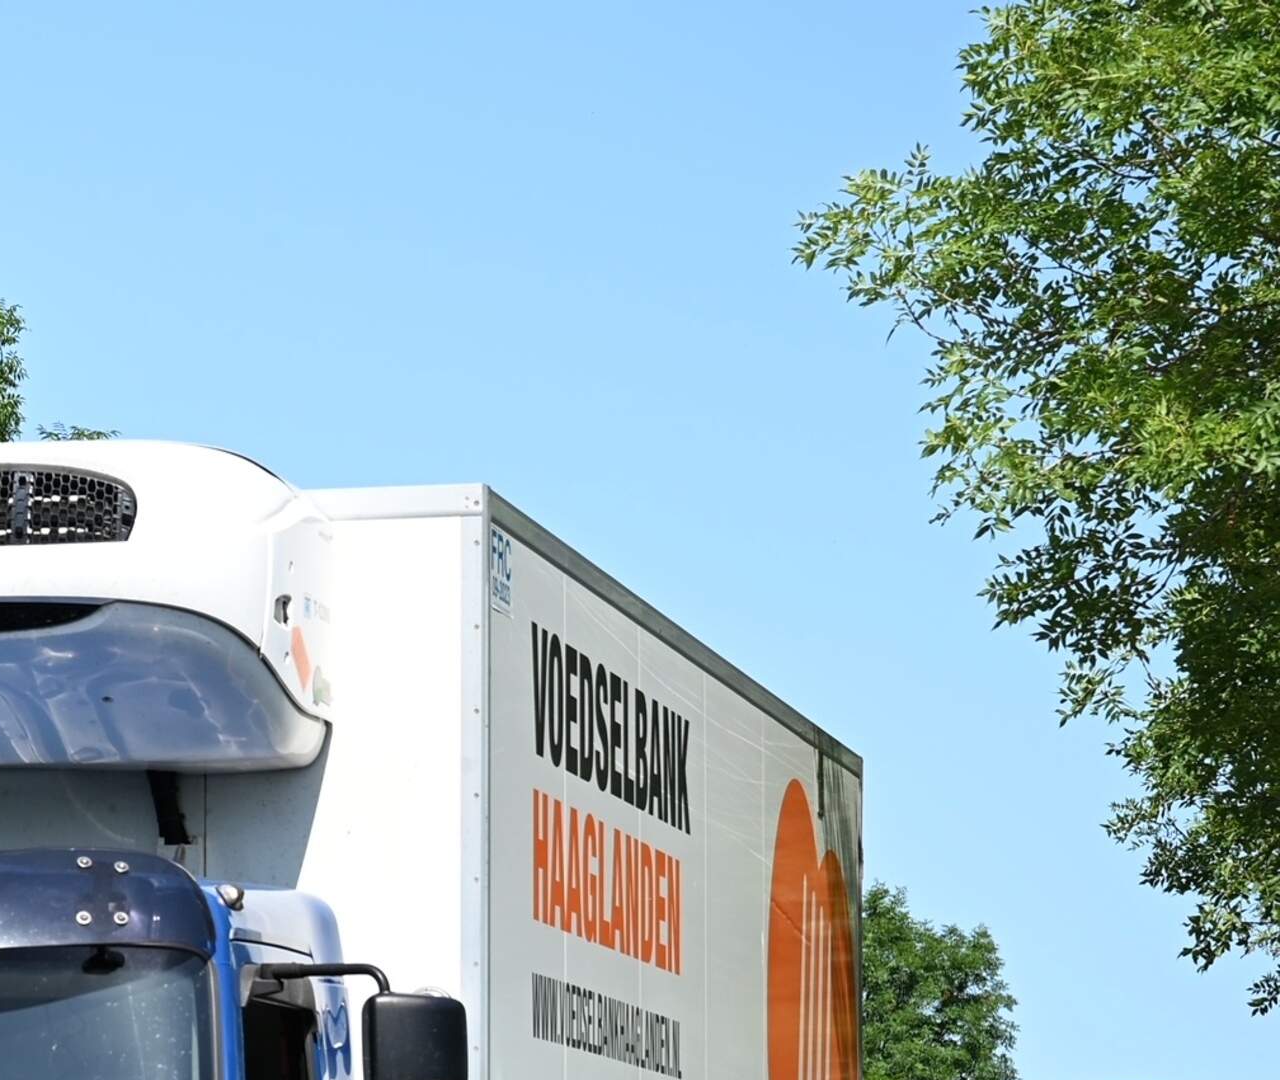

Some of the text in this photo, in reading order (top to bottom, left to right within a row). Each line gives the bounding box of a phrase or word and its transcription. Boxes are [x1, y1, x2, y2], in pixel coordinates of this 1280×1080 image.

[491, 528, 512, 582] FRC
[531, 620, 691, 836] VOEDSELBANK
[533, 788, 681, 976] HAAGLANDEN
